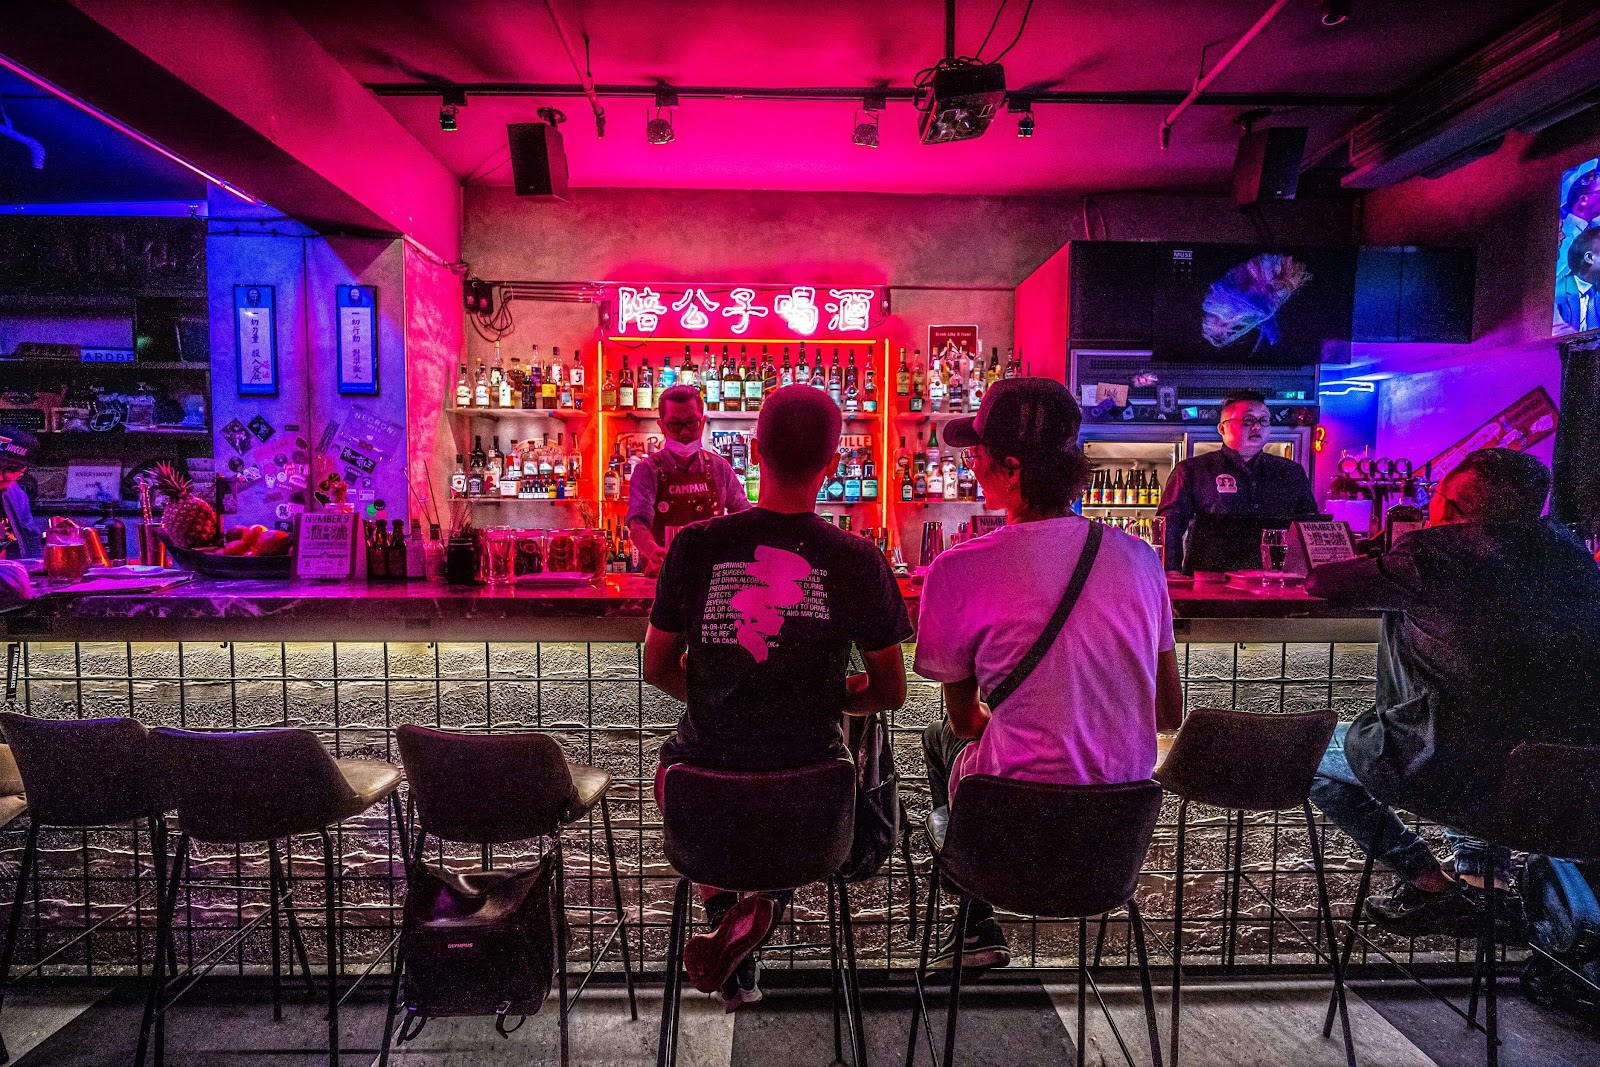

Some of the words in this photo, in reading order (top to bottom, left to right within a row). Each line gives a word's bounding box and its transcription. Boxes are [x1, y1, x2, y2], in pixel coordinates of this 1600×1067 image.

[618, 286, 874, 335] 陪公子喝酒
[84, 352, 133, 361] ARDBE
[668, 482, 709, 495] CAMPARI
[305, 514, 342, 524] NUMBER
[343, 514, 350, 522] 9
[980, 517, 1007, 527] NUMBE
[1302, 523, 1337, 531] NUMBER
[712, 561, 749, 571] GOVERNMEN
[721, 569, 745, 577] SURGEO
[820, 569, 827, 577] TO
[710, 578, 720, 586] NOT
[803, 582, 823, 590] DURING
[811, 590, 828, 599] BIRTH
[706, 599, 730, 607] BEVERAG
[803, 596, 824, 605] OHOLIC
[809, 604, 826, 612] DRIVE
